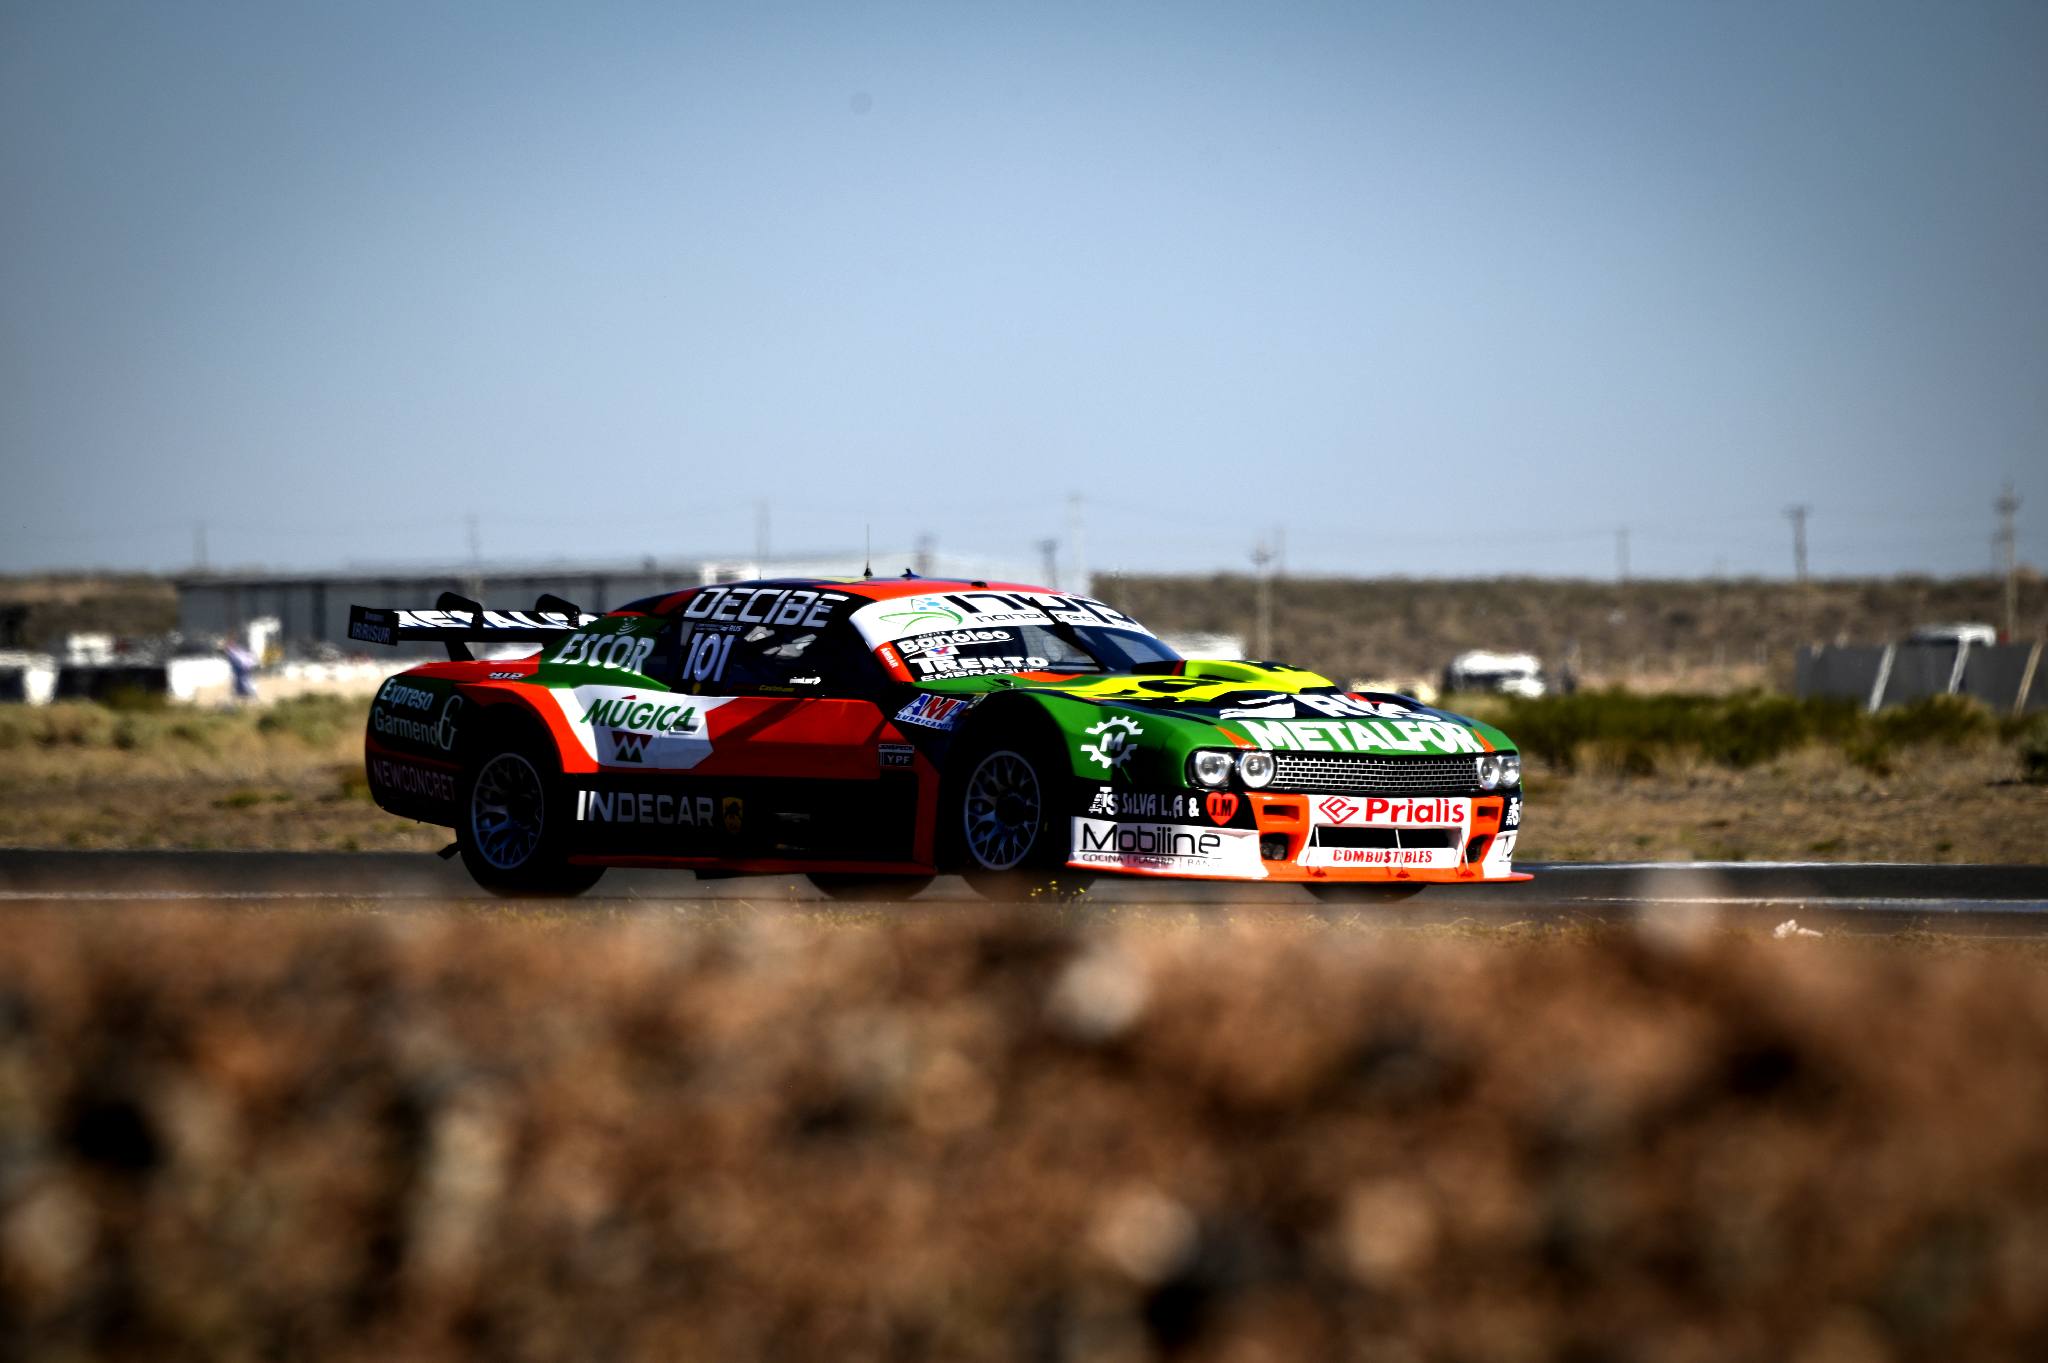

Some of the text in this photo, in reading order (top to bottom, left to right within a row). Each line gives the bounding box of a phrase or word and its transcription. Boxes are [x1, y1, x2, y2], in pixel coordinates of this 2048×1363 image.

[683, 587, 850, 628] DECIBE
[549, 633, 657, 675] ESCOR
[682, 632, 735, 681] 101
[909, 655, 1049, 674] TRENTO
[379, 678, 435, 711] Expreso
[580, 695, 696, 731] MÚGICA
[1237, 720, 1486, 752] METALFOR
[887, 755, 911, 765] YPF
[576, 790, 714, 827] INDECAR
[1188, 797, 1199, 817] &
[1365, 798, 1465, 823] Prialis
[1082, 822, 1221, 854] Mobiline
[1082, 853, 1124, 863] COCINA
